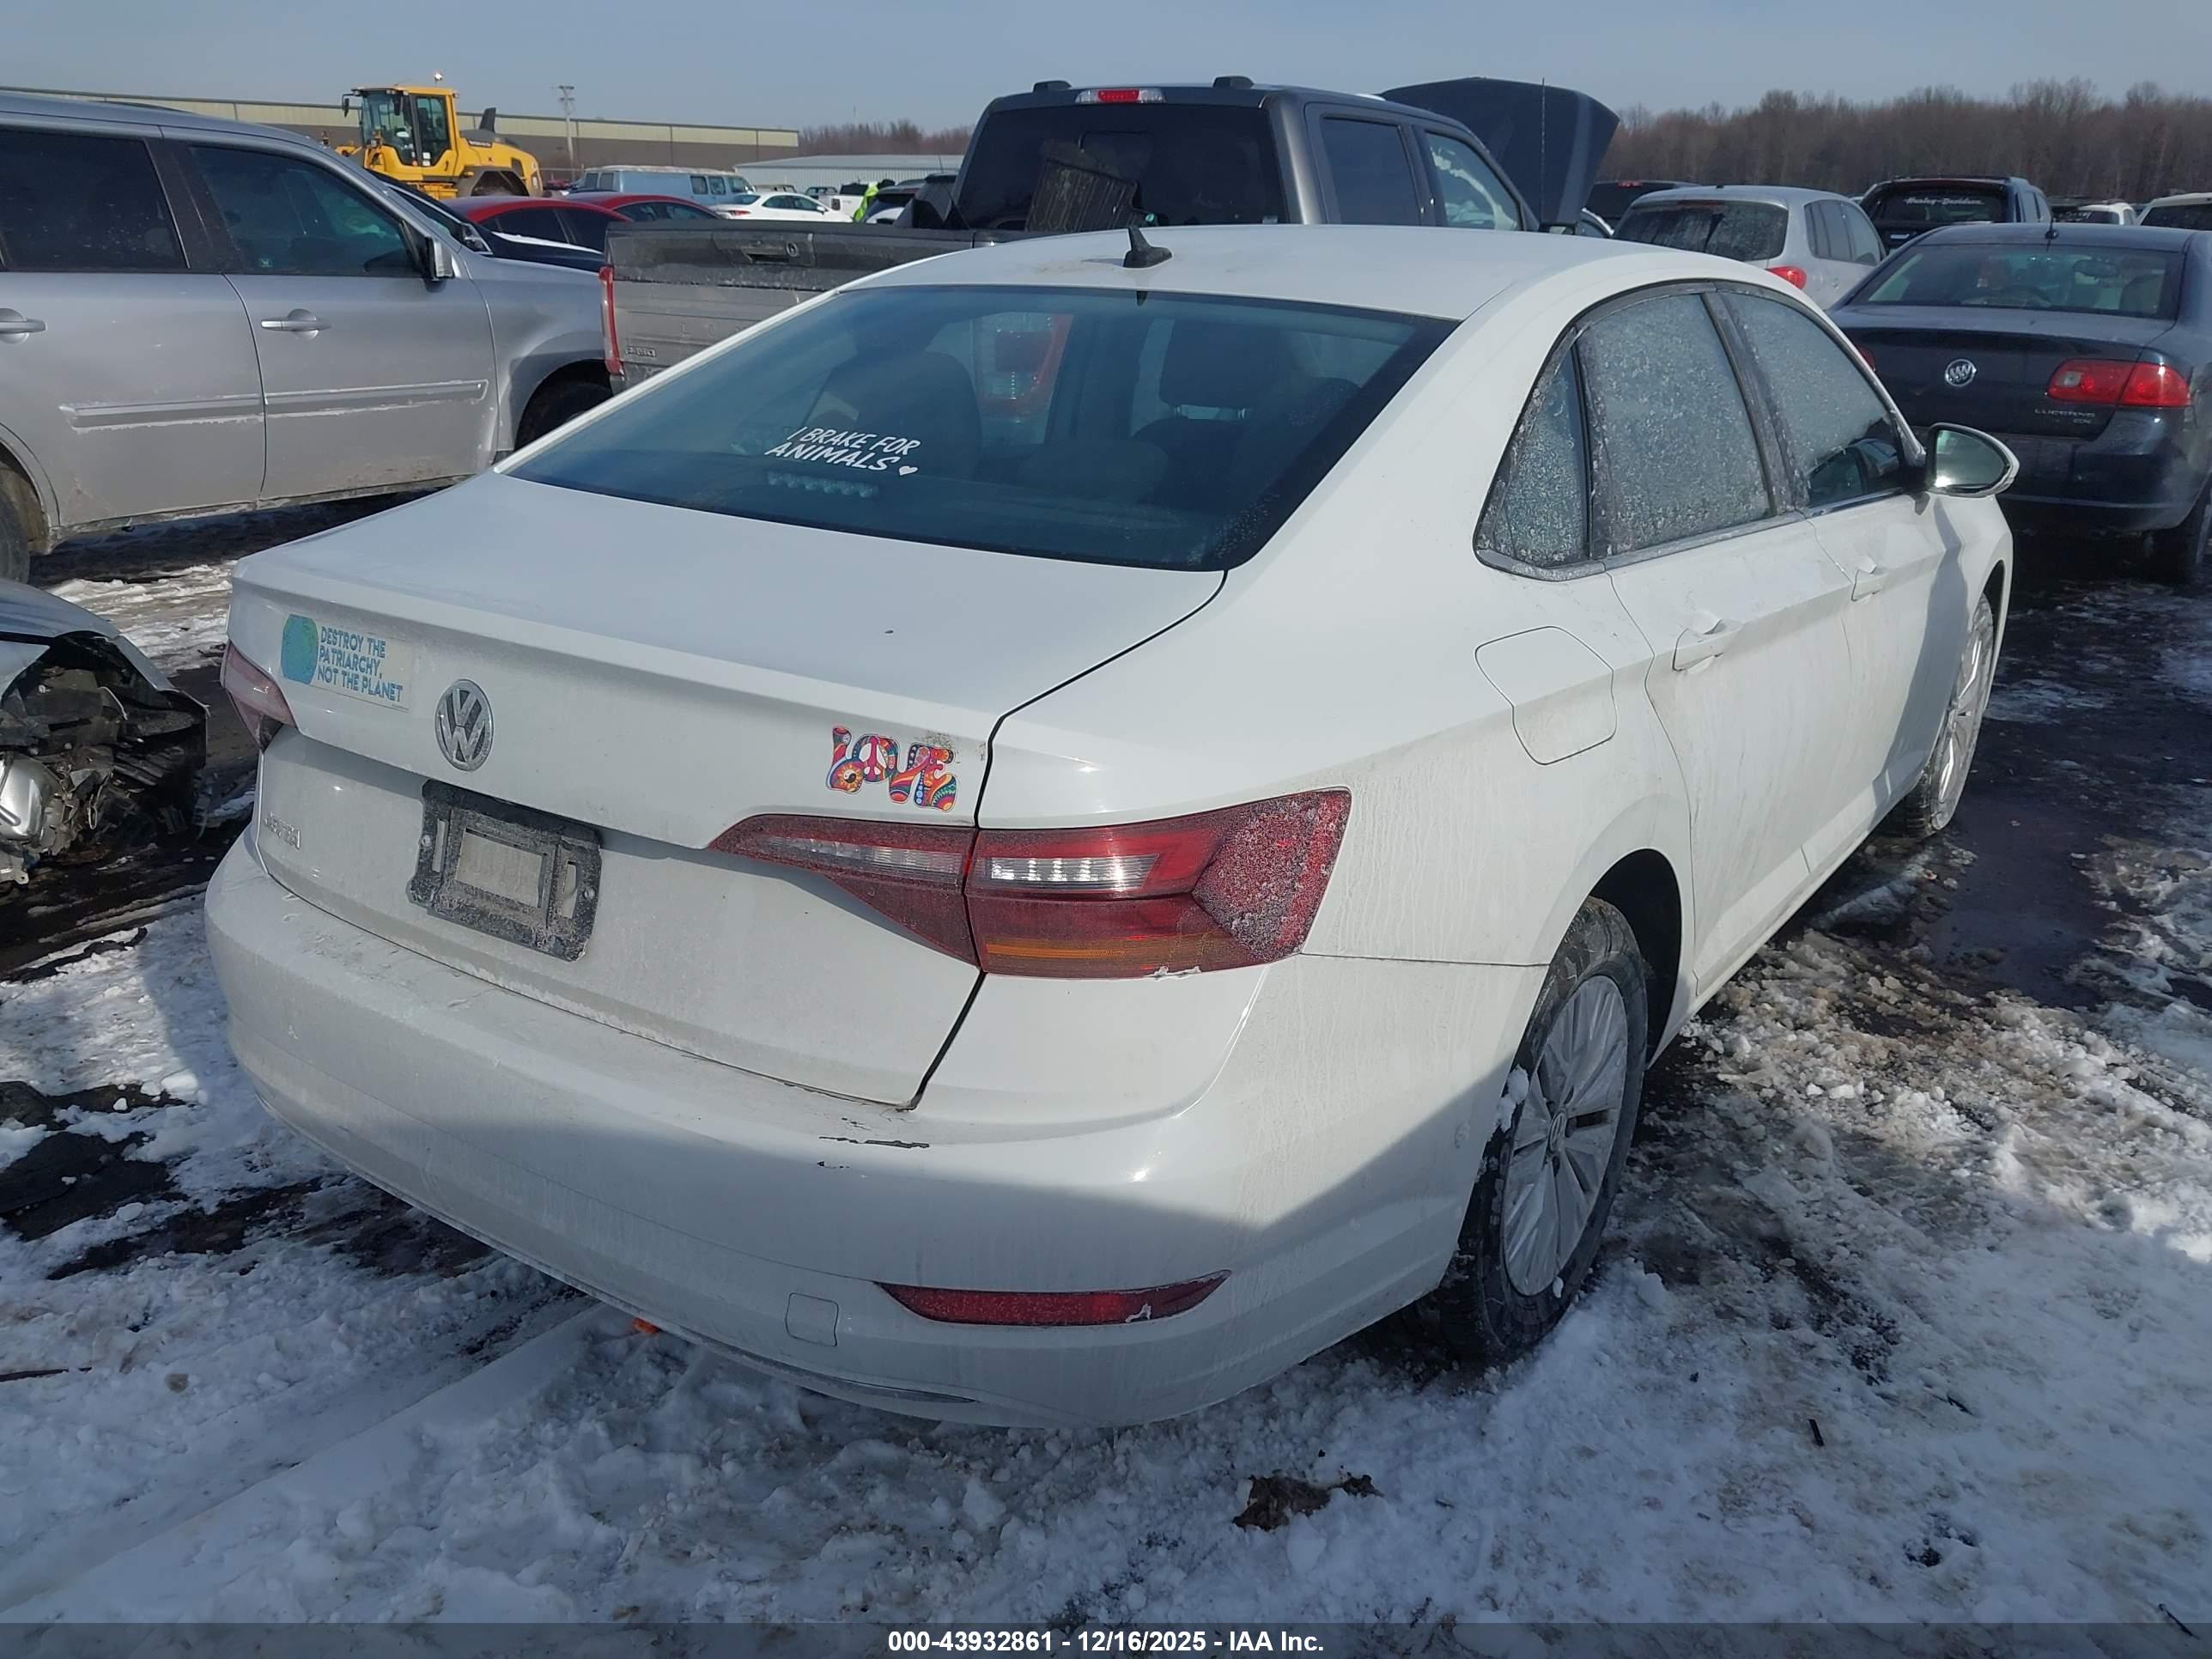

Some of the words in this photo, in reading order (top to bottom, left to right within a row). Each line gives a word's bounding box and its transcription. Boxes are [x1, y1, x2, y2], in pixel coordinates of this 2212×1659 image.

[763, 441, 901, 471] ANIMALS
[787, 426, 808, 441] I
[799, 428, 878, 449] BRAKE
[869, 436, 921, 456] FOR
[321, 626, 364, 653] DESTROY
[367, 637, 386, 659] THE
[319, 645, 382, 680] PATRIARCHY,
[318, 665, 338, 686] NOT
[342, 670, 360, 691] THE
[362, 675, 404, 702] PLANET
[827, 725, 957, 812] LOVE
